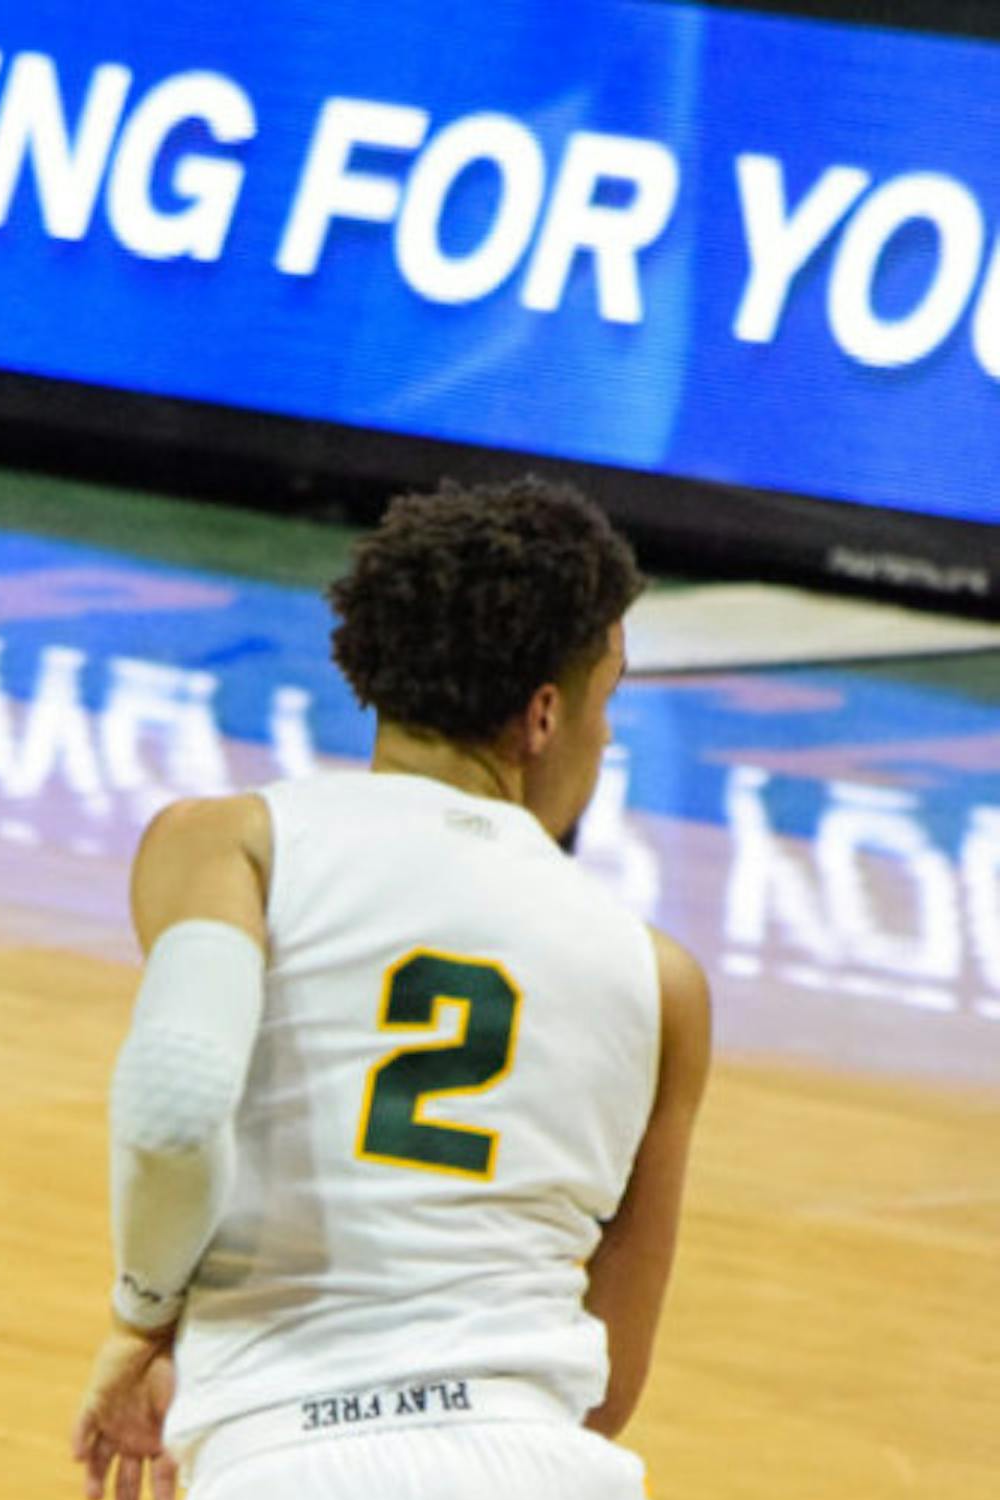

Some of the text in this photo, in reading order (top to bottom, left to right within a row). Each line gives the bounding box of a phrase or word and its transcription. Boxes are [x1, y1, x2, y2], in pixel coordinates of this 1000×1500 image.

[274, 95, 680, 325] FOR
[732, 152, 1000, 382] YO
[355, 947, 522, 1181] 2
[301, 1380, 473, 1432] PLAY FREE
